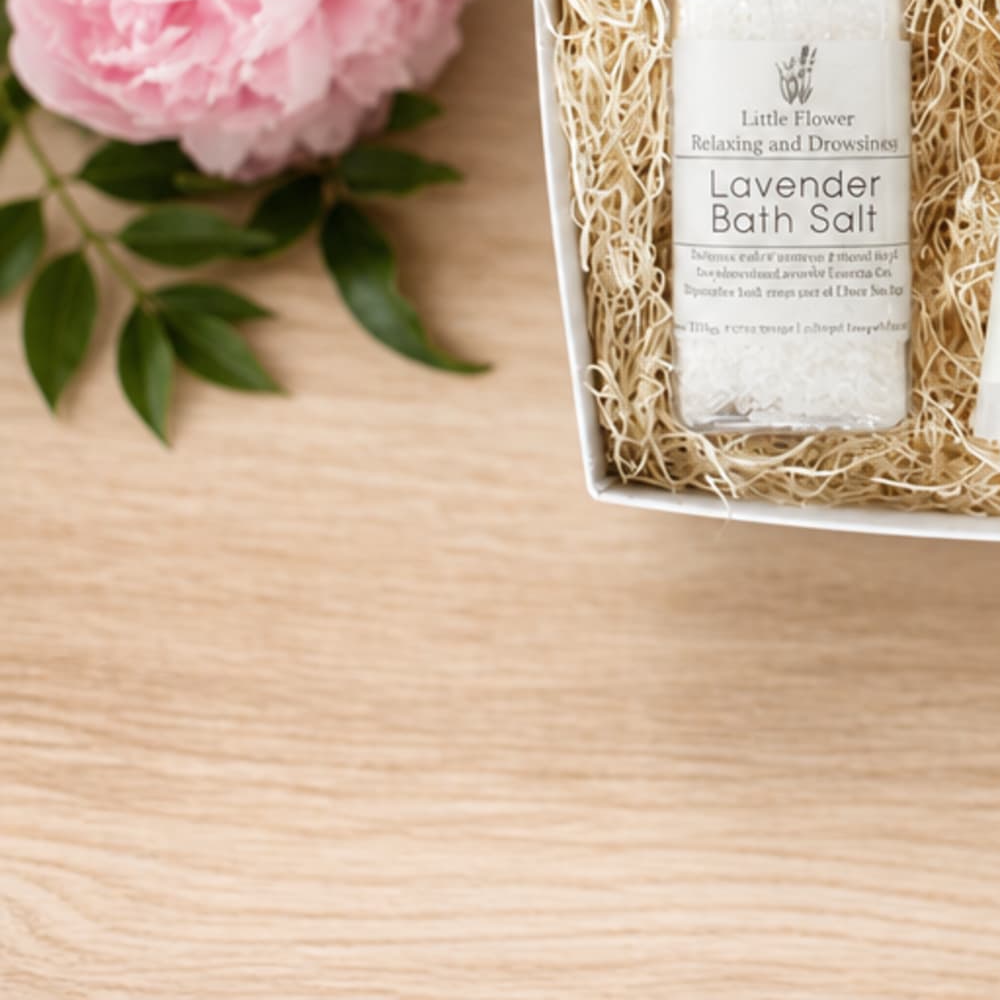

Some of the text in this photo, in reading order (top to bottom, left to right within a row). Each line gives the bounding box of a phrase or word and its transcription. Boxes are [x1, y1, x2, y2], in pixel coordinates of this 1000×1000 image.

[741, 109, 855, 127] Little Flower
[691, 134, 763, 155] Relaxing
[768, 134, 801, 151] and
[710, 169, 881, 199] Lavender
[711, 203, 878, 234] Bath Salt
